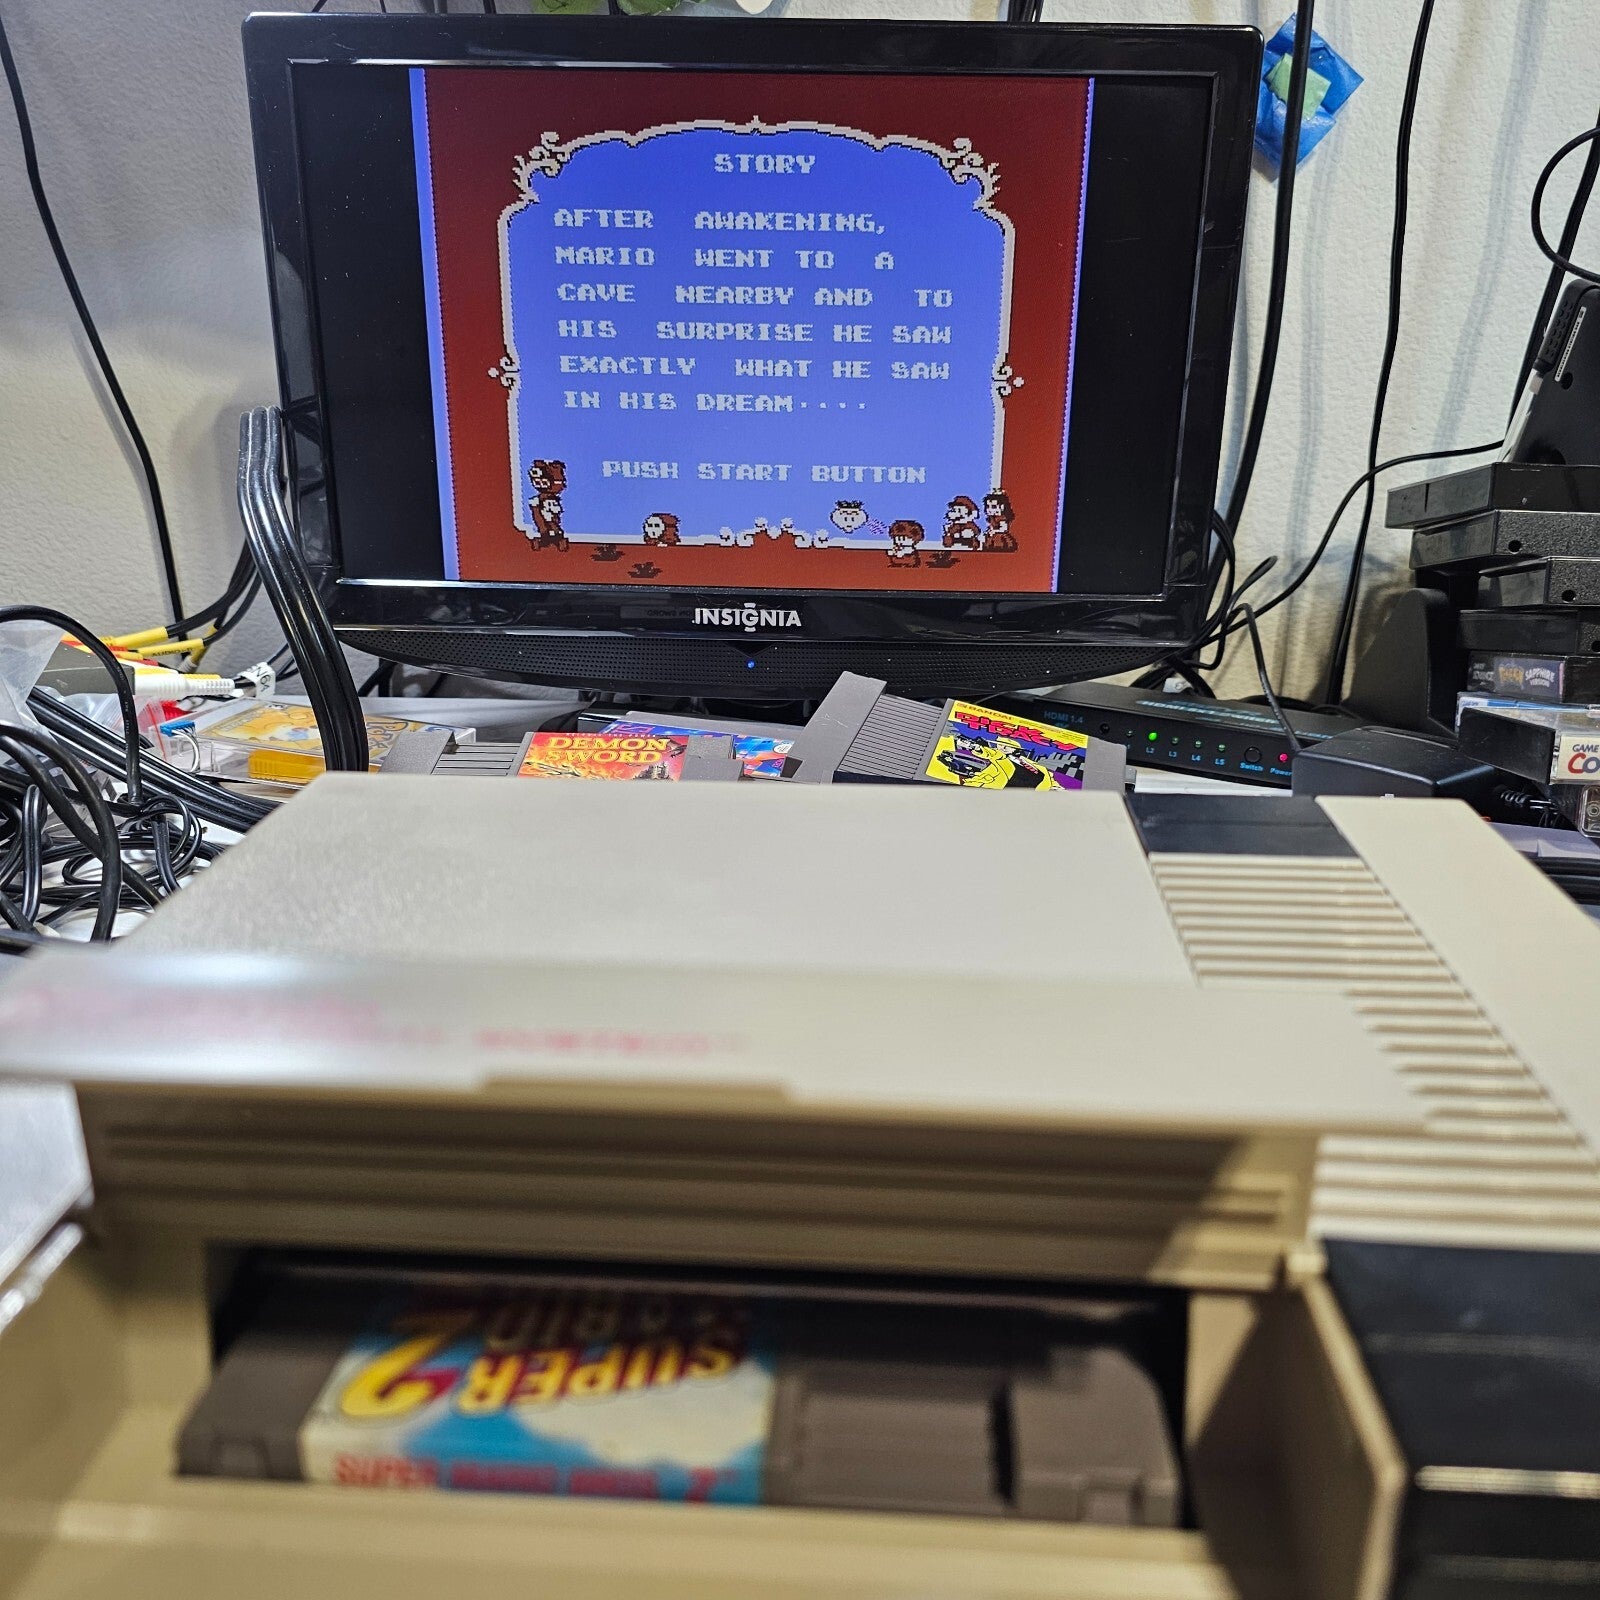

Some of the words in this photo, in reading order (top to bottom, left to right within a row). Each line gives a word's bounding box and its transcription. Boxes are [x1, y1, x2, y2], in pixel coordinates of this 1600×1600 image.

[714, 153, 816, 175] STORY
[553, 208, 654, 229] AFTER
[694, 211, 886, 236] AWAKENING,
[554, 246, 656, 267] MARIO
[694, 248, 772, 269] WENT
[794, 250, 836, 270] TO
[873, 251, 896, 271] A
[556, 282, 636, 304] CAVE
[675, 285, 794, 306] NEARBY
[813, 287, 875, 307] AND
[914, 289, 954, 308] TO
[558, 319, 618, 339] HIS
[656, 321, 814, 343] SURPRISE
[832, 324, 873, 344] HE
[891, 325, 953, 345] SAW
[559, 355, 697, 376] EXACTLY
[734, 358, 814, 379] WHAT
[832, 360, 873, 380] HE
[890, 361, 951, 381] SAW
[563, 390, 600, 410] IN
[619, 391, 678, 411] HIS
[602, 460, 680, 480] PUSH
[697, 462, 794, 482] START
[811, 464, 928, 484] BUTTON
[694, 605, 802, 630] INSIGNIA
[954, 711, 1043, 736] DICK
[1043, 710, 1069, 722] HDMI
[1070, 714, 1085, 724] 1.4
[547, 736, 669, 752] DEMON
[961, 717, 1080, 751] TRACY
[544, 750, 662, 764] SWORD
[1145, 746, 1155, 754] L2
[1168, 750, 1178, 758] L3
[1191, 754, 1202, 762] L4
[1572, 743, 1600, 753] GAME
[1214, 758, 1226, 766] L5
[1239, 761, 1265, 772] Switch
[341, 1312, 472, 1418] 2
[457, 1336, 738, 1414] SUPER
